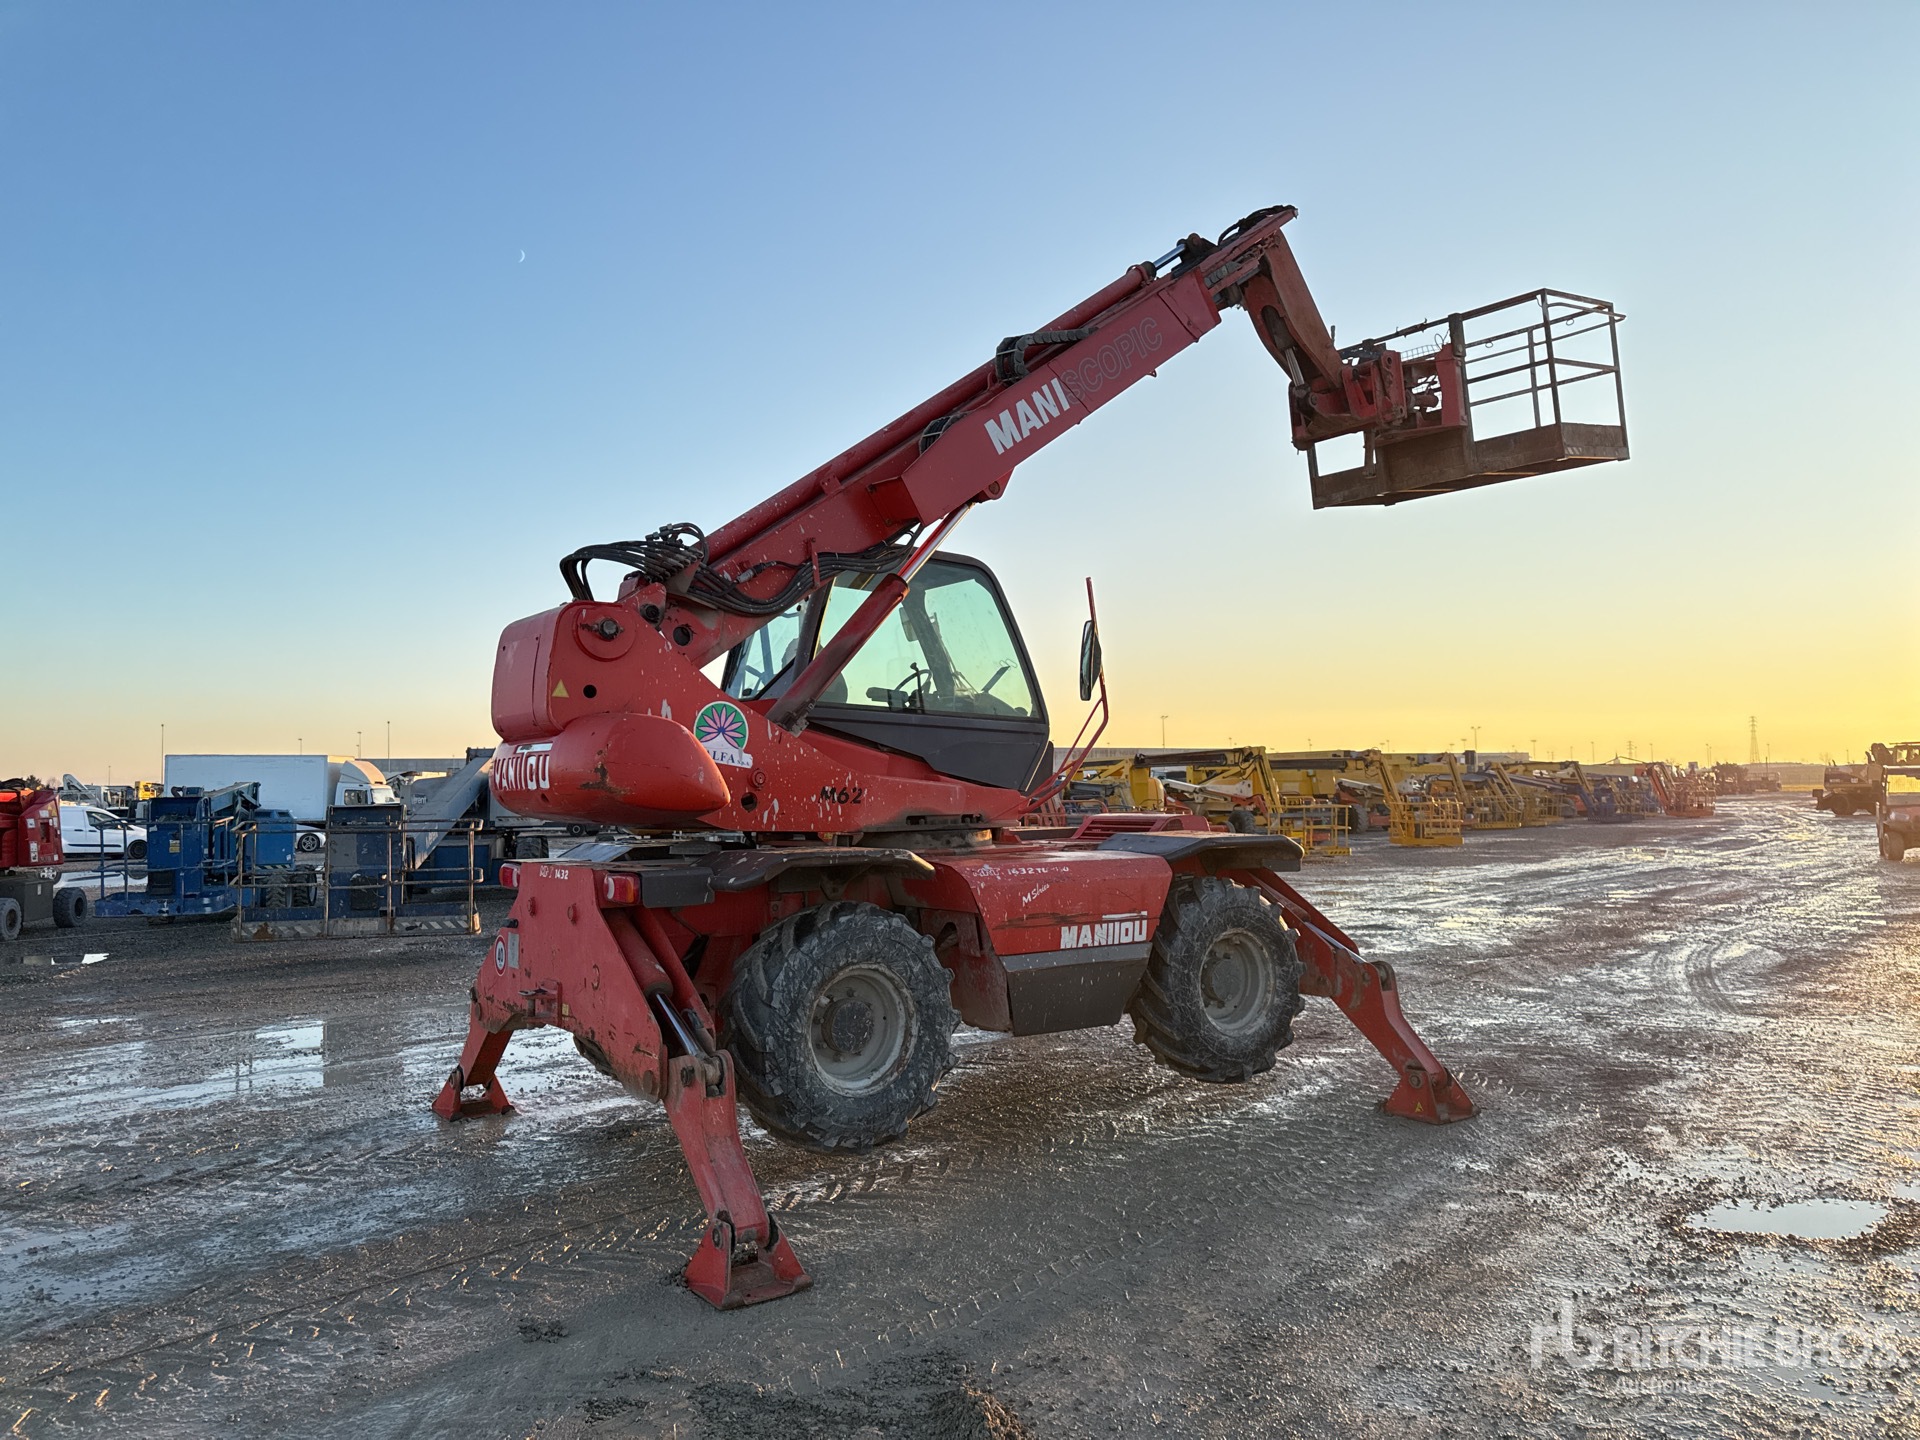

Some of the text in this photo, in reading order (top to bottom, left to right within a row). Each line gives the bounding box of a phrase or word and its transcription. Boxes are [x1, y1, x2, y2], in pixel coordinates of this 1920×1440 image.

[818, 786, 863, 804] M62
[555, 869, 569, 880] 1432
[1060, 911, 1148, 950] MANITOU
